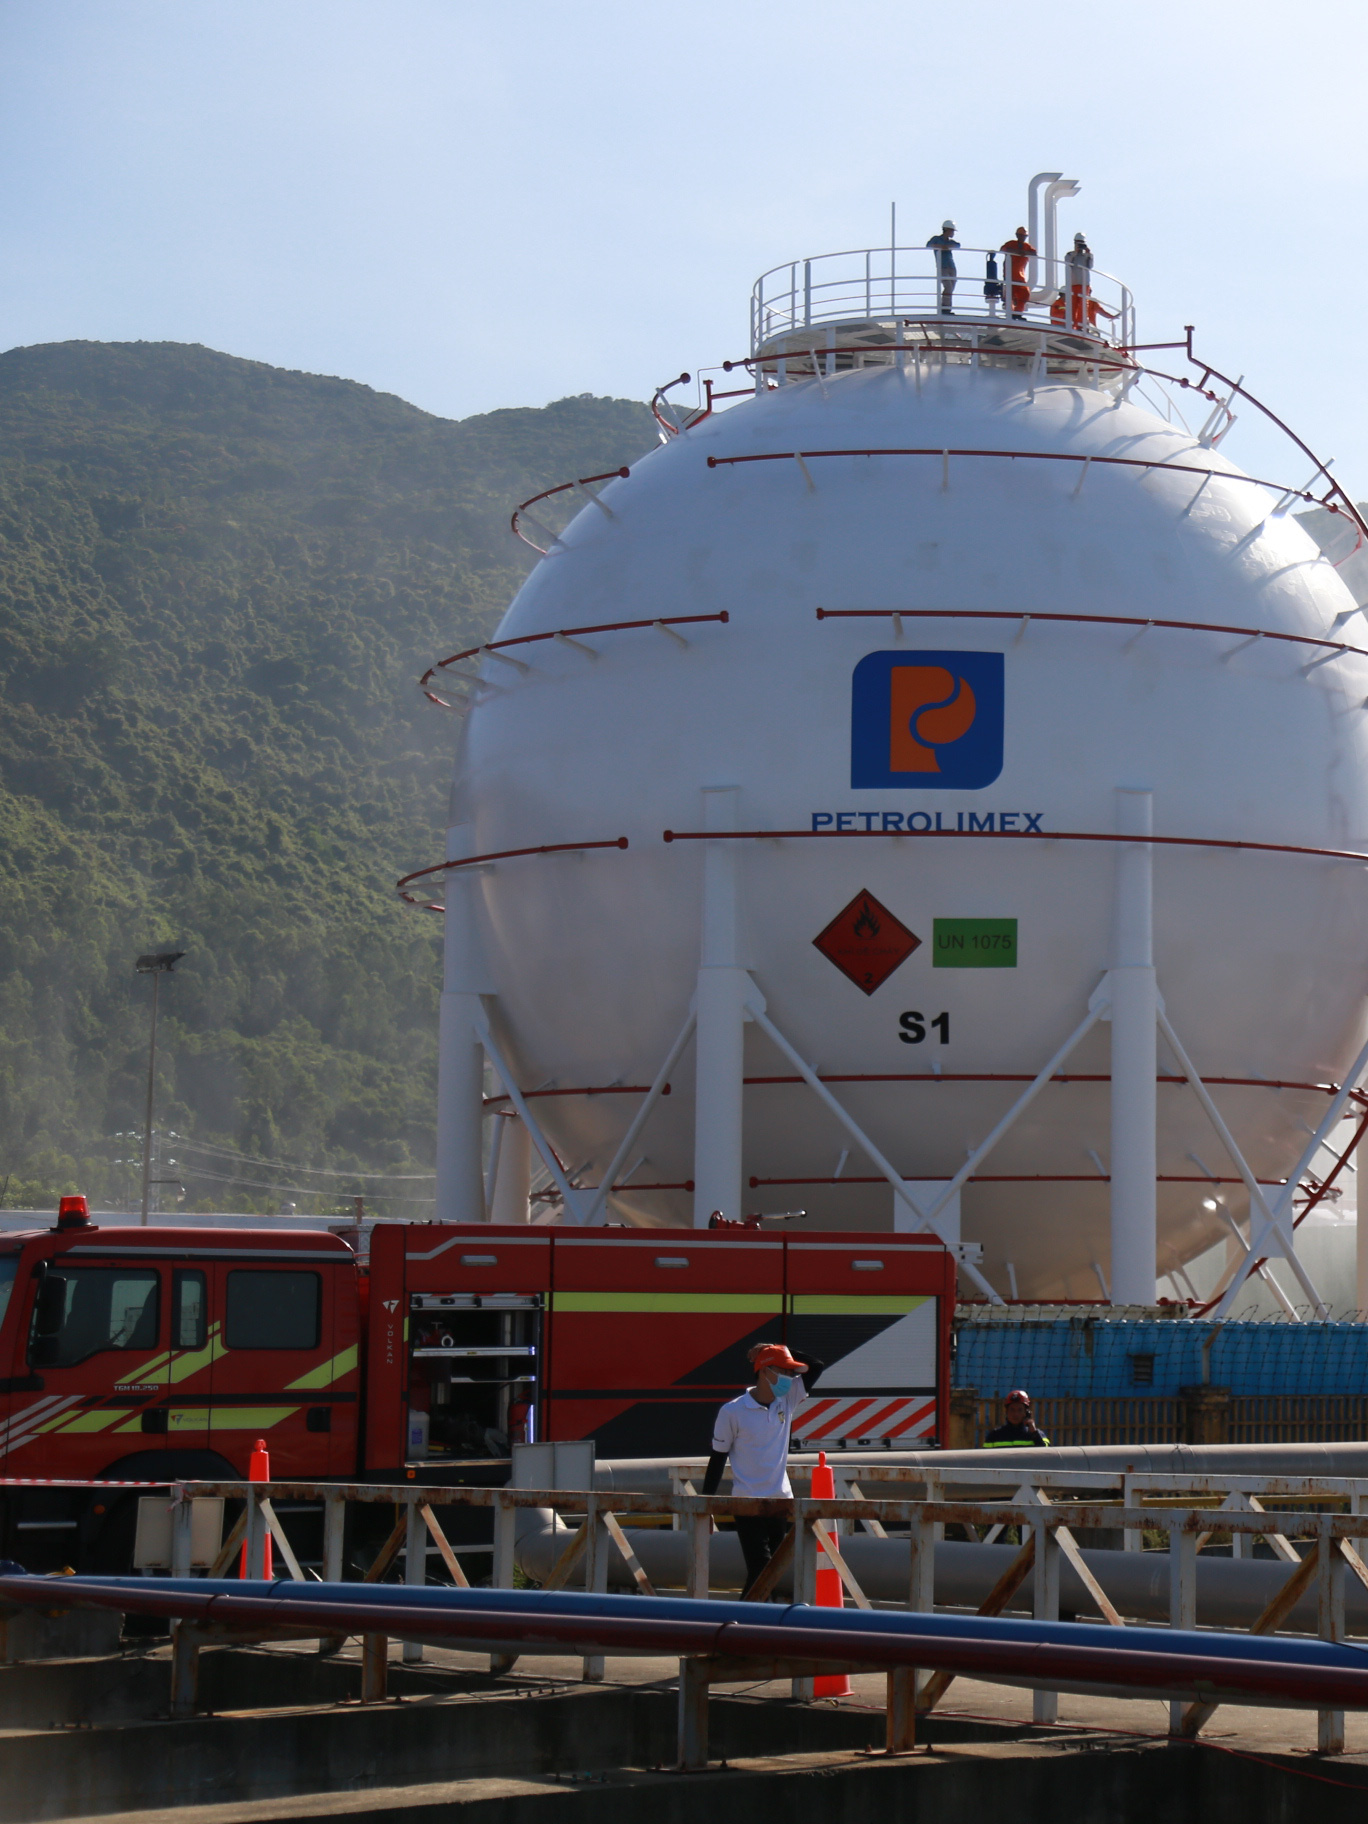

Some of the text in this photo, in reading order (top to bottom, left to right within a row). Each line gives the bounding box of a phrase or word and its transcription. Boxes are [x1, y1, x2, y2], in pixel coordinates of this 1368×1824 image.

[811, 811, 1044, 833] PETROLIMEX
[938, 934, 1012, 950] UN 1075
[864, 972, 873, 984] 2
[898, 1011, 950, 1045] S1
